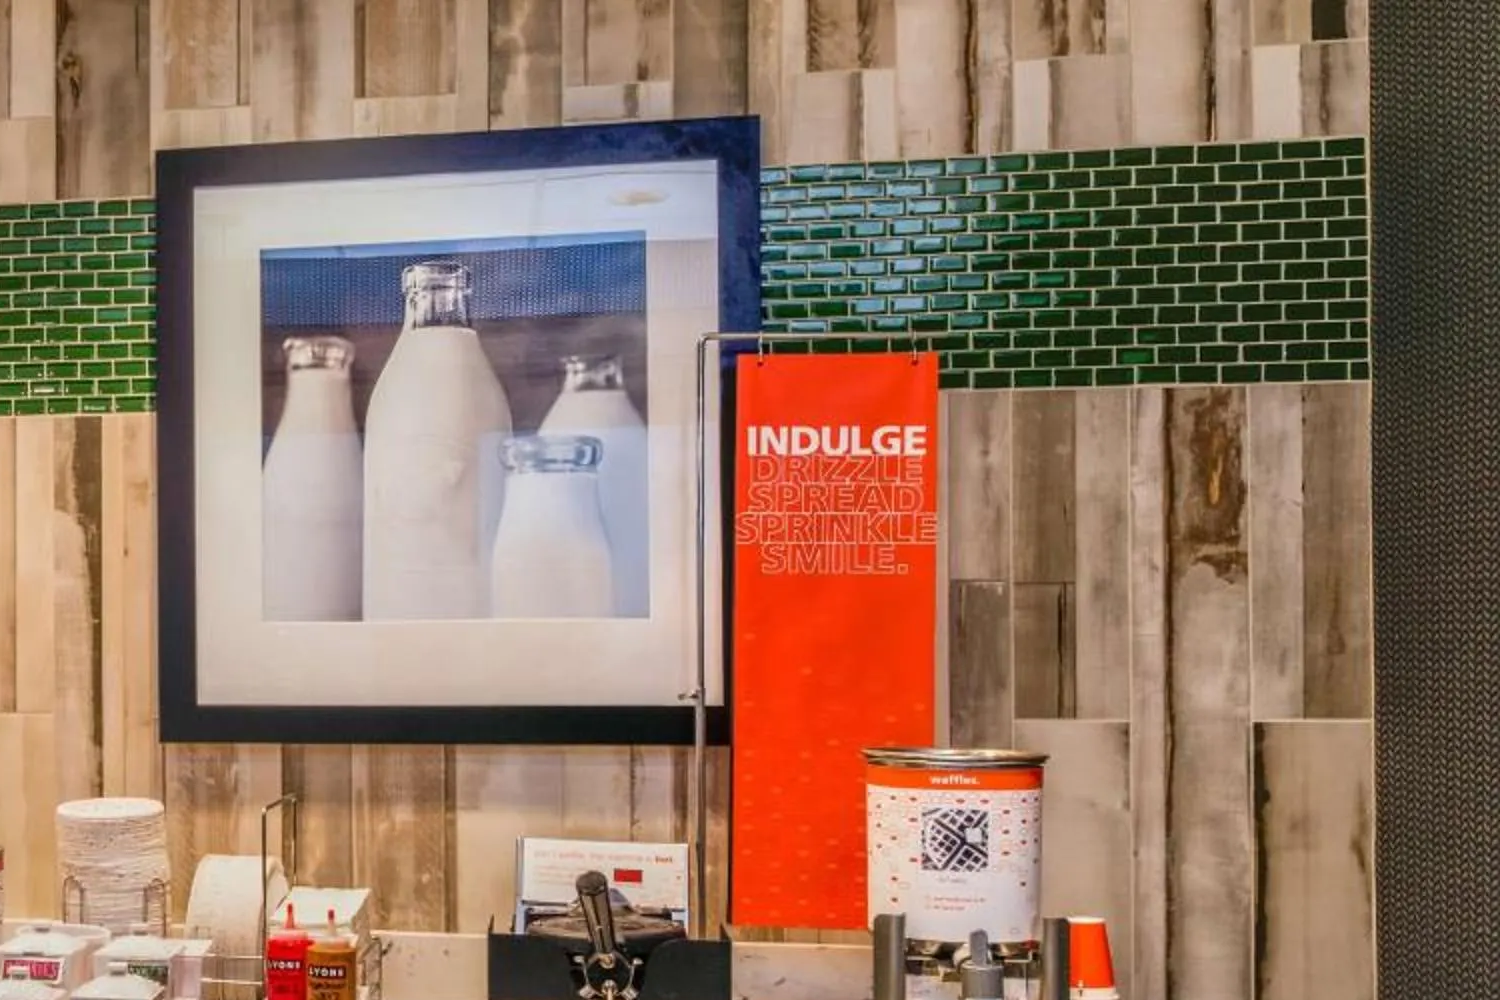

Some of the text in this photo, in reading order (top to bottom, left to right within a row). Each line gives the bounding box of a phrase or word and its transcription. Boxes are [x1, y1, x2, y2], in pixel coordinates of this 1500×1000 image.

[747, 425, 927, 456] INDULGE
[751, 455, 924, 485] DRIZZLE
[748, 482, 924, 513] SPREAD
[736, 511, 939, 545] SPRINKLE
[761, 543, 910, 575] SMILE.
[308, 966, 345, 978] LYONS
